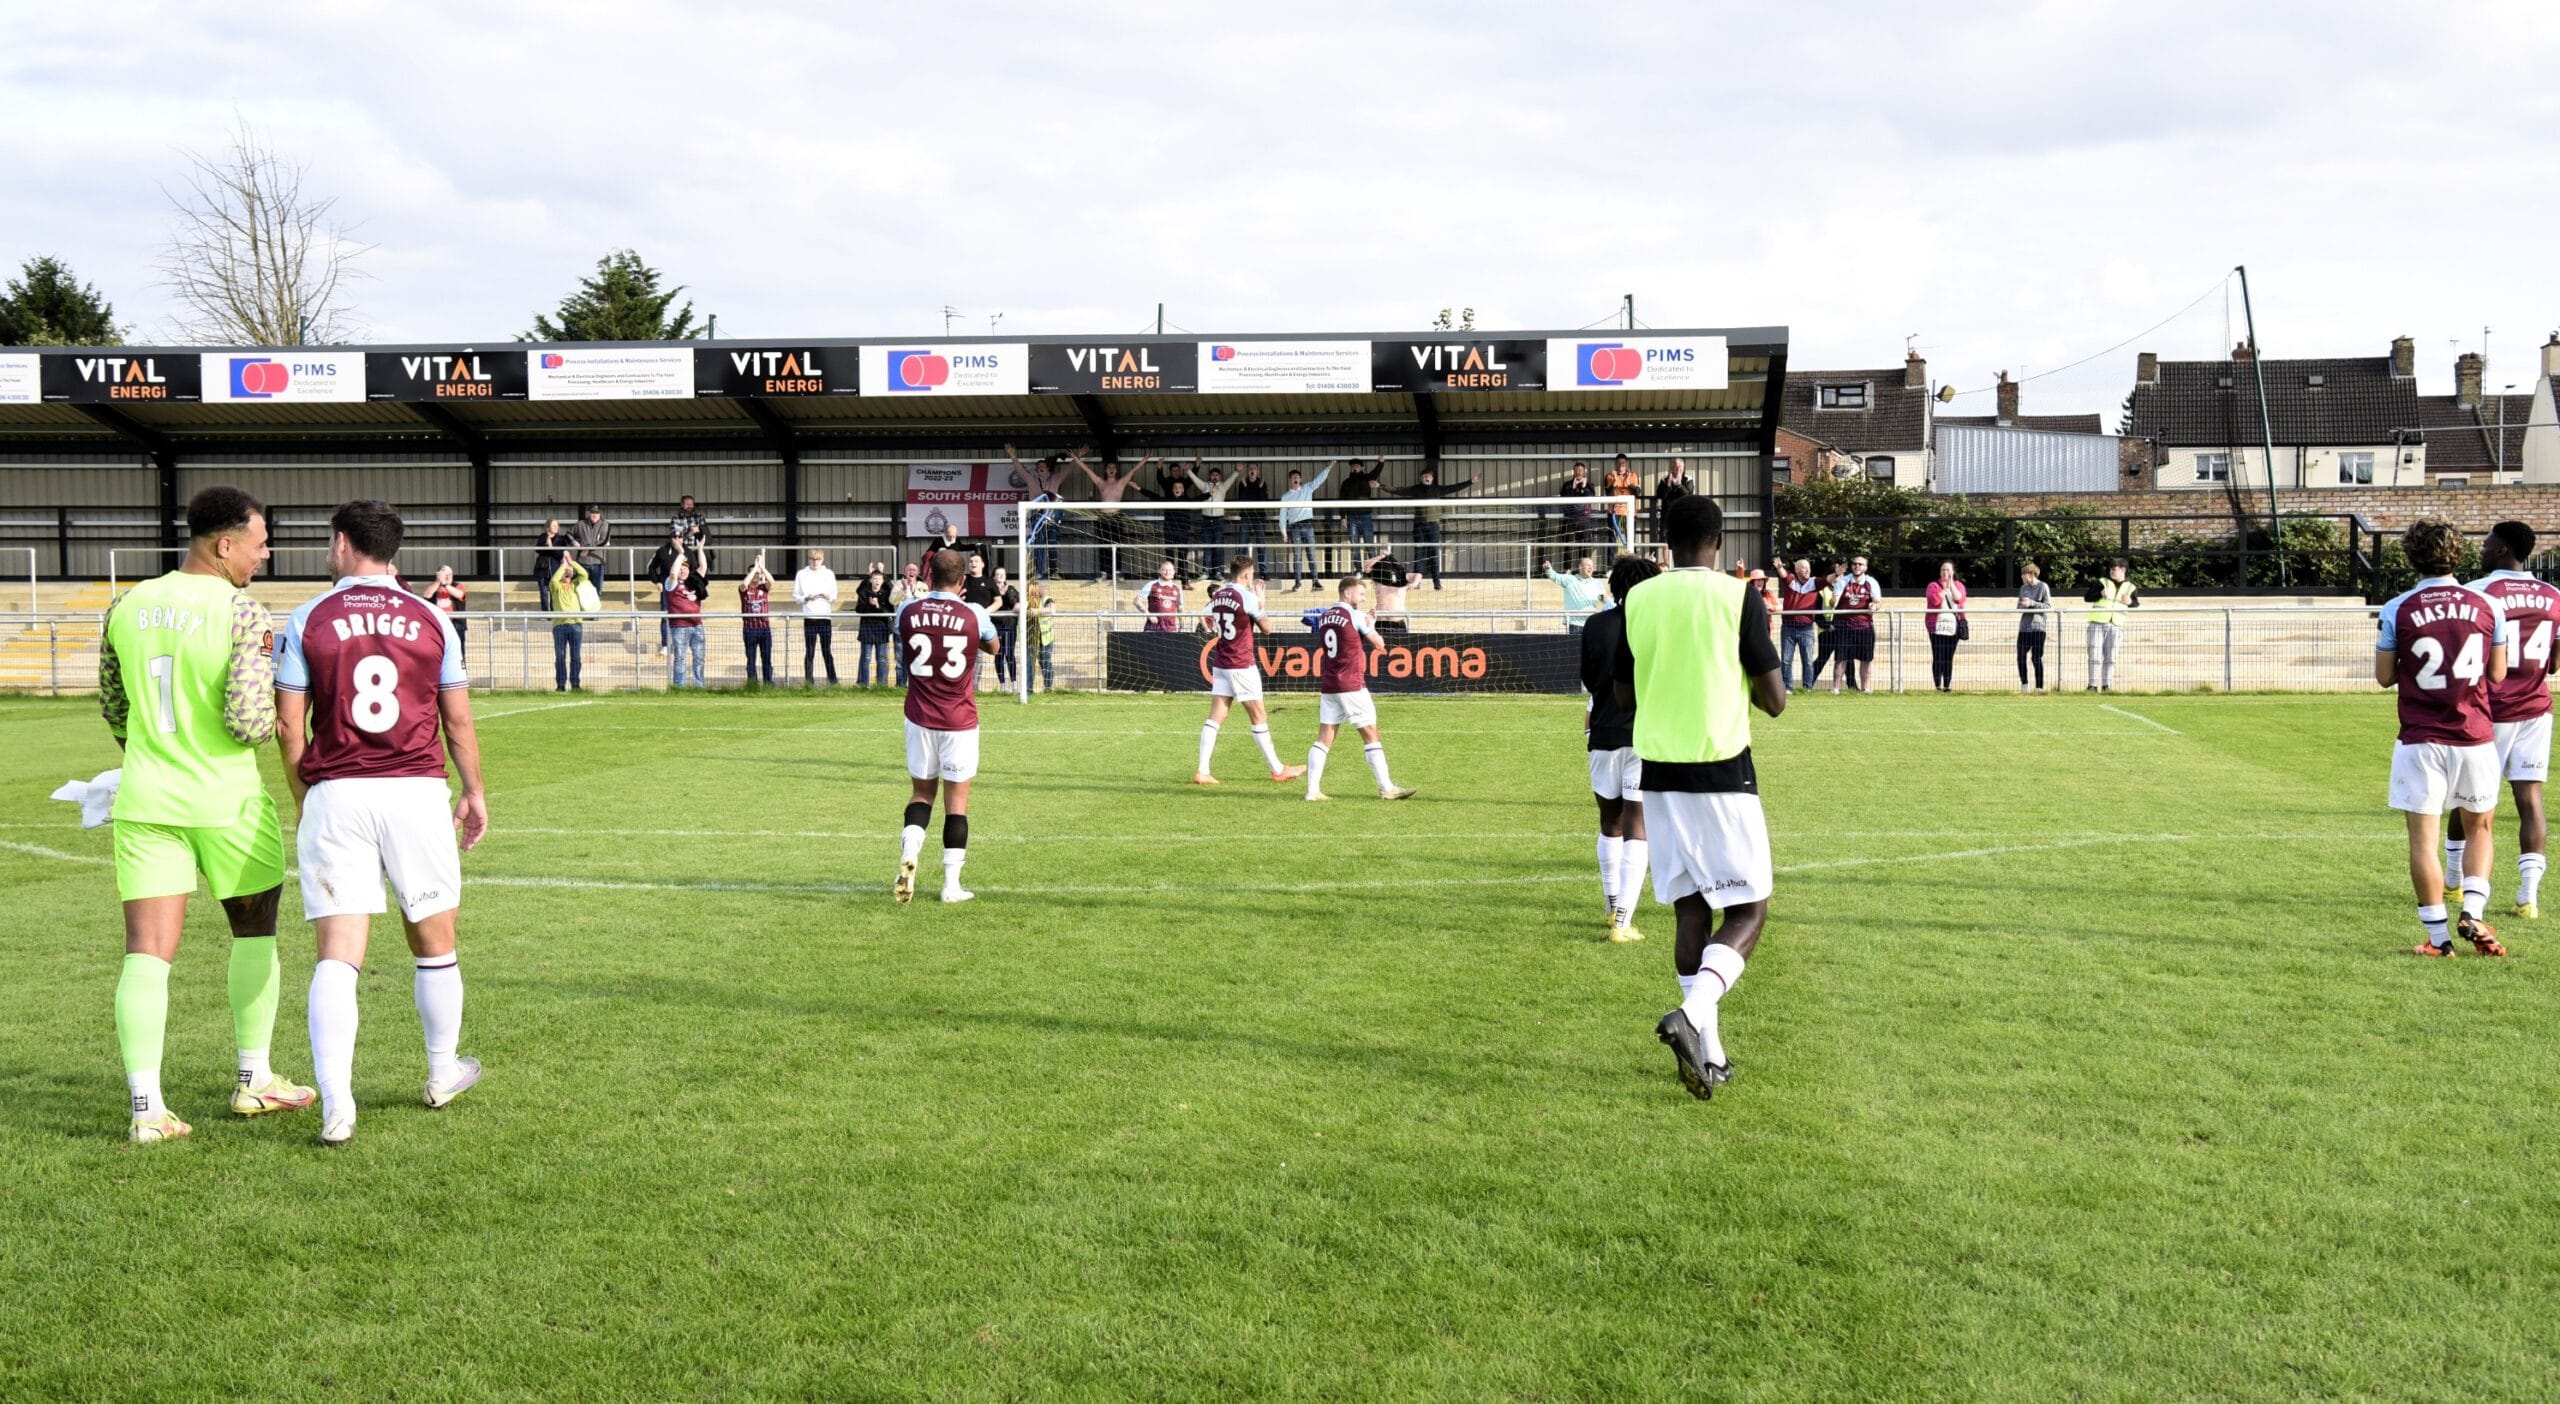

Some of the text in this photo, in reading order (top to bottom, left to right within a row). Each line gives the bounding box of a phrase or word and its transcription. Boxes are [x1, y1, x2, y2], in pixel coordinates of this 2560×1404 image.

[730, 352, 822, 377] VITAL
[953, 355, 999, 368] PIMS
[1066, 348, 1160, 373] VITAL
[1410, 345, 1507, 371] VITAL
[1646, 348, 1695, 362] PIMS
[75, 358, 166, 383] VITAL
[293, 363, 337, 376] PIMS
[401, 356, 492, 381] VITAL
[1647, 365, 1694, 373] Dedicated to
[293, 379, 337, 387] Dedicated to
[916, 468, 962, 476] CHAMPIONS
[917, 491, 961, 501] SOUTH
[963, 491, 1018, 501] SHIELDS
[343, 593, 385, 603] Darling's
[343, 601, 386, 609] Pharmacy
[2420, 590, 2452, 600] Darling's
[138, 606, 205, 636] BONEY
[332, 612, 421, 642] BRIGGS
[910, 613, 965, 632] MARTIN
[2410, 603, 2480, 628] HASANI
[908, 633, 968, 679] 23
[1324, 628, 1338, 659] 9
[2506, 620, 2553, 669] 14
[2411, 633, 2485, 691] 24
[149, 654, 177, 733] 1
[351, 654, 400, 734] 8
